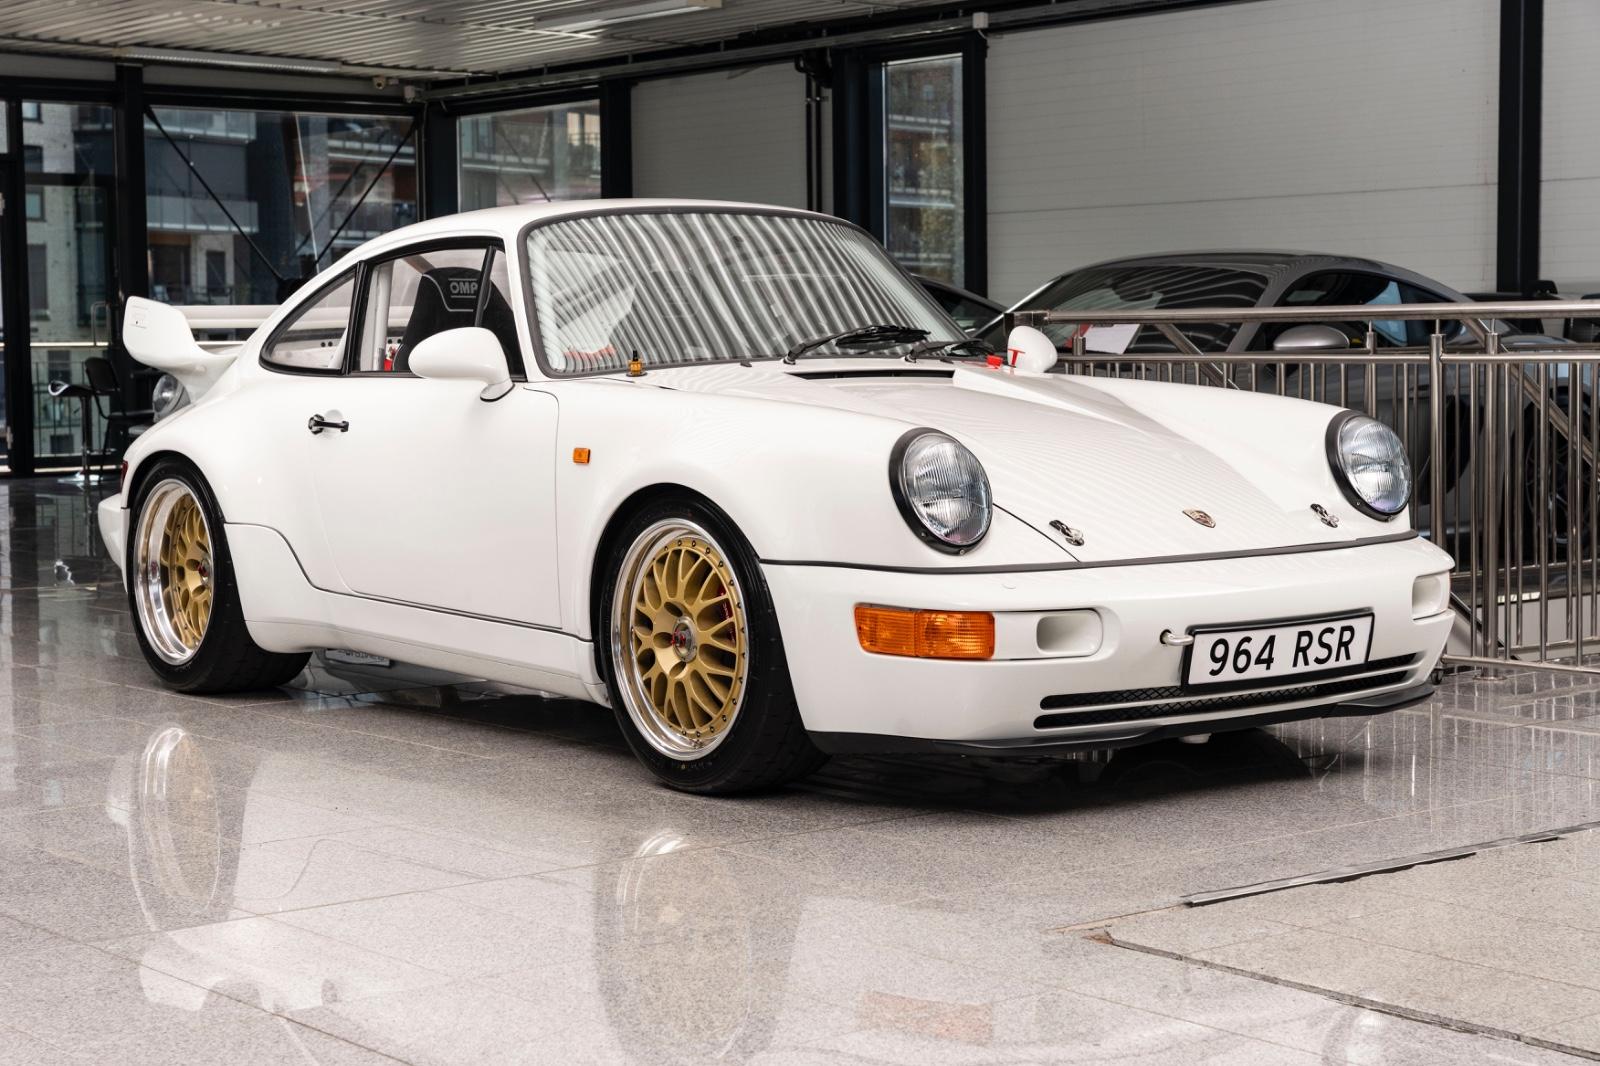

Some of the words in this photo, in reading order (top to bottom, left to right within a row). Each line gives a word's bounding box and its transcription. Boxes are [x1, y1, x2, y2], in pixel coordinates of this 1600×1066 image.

[449, 281, 478, 294] OMP
[1209, 635, 1276, 676] 964
[1292, 625, 1355, 667] RSR
